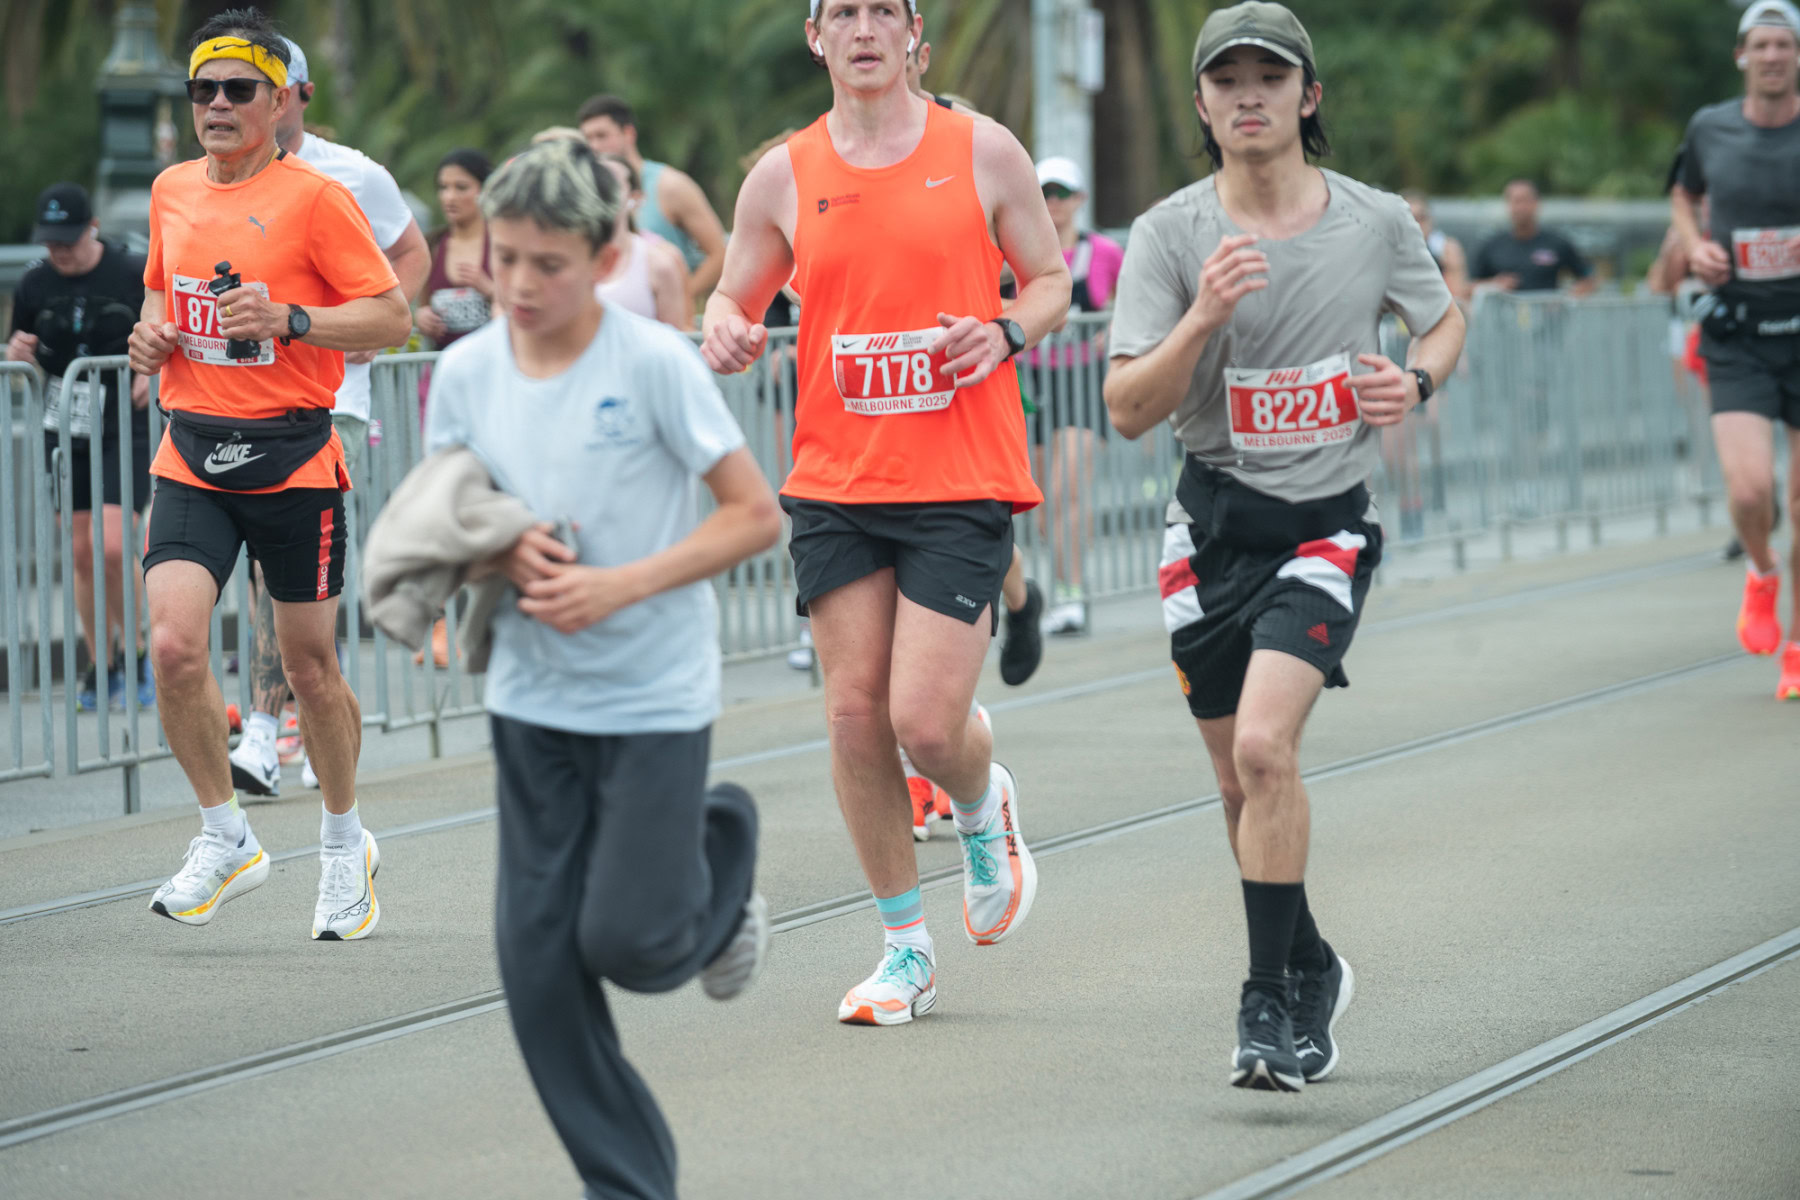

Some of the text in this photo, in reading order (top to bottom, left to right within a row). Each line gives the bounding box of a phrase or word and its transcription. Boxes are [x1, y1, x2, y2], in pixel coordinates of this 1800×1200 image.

[184, 335, 227, 351] MELBOURN
[855, 352, 933, 397] 7178
[851, 394, 948, 412] MELBOURNE 2025
[1251, 381, 1341, 432] 8224
[1243, 425, 1353, 447] MELBOURNE 2025
[212, 443, 252, 462] NIKE
[317, 562, 328, 596] Trac
[955, 594, 976, 608] 2XU
[1002, 800, 1019, 857] HOKA
